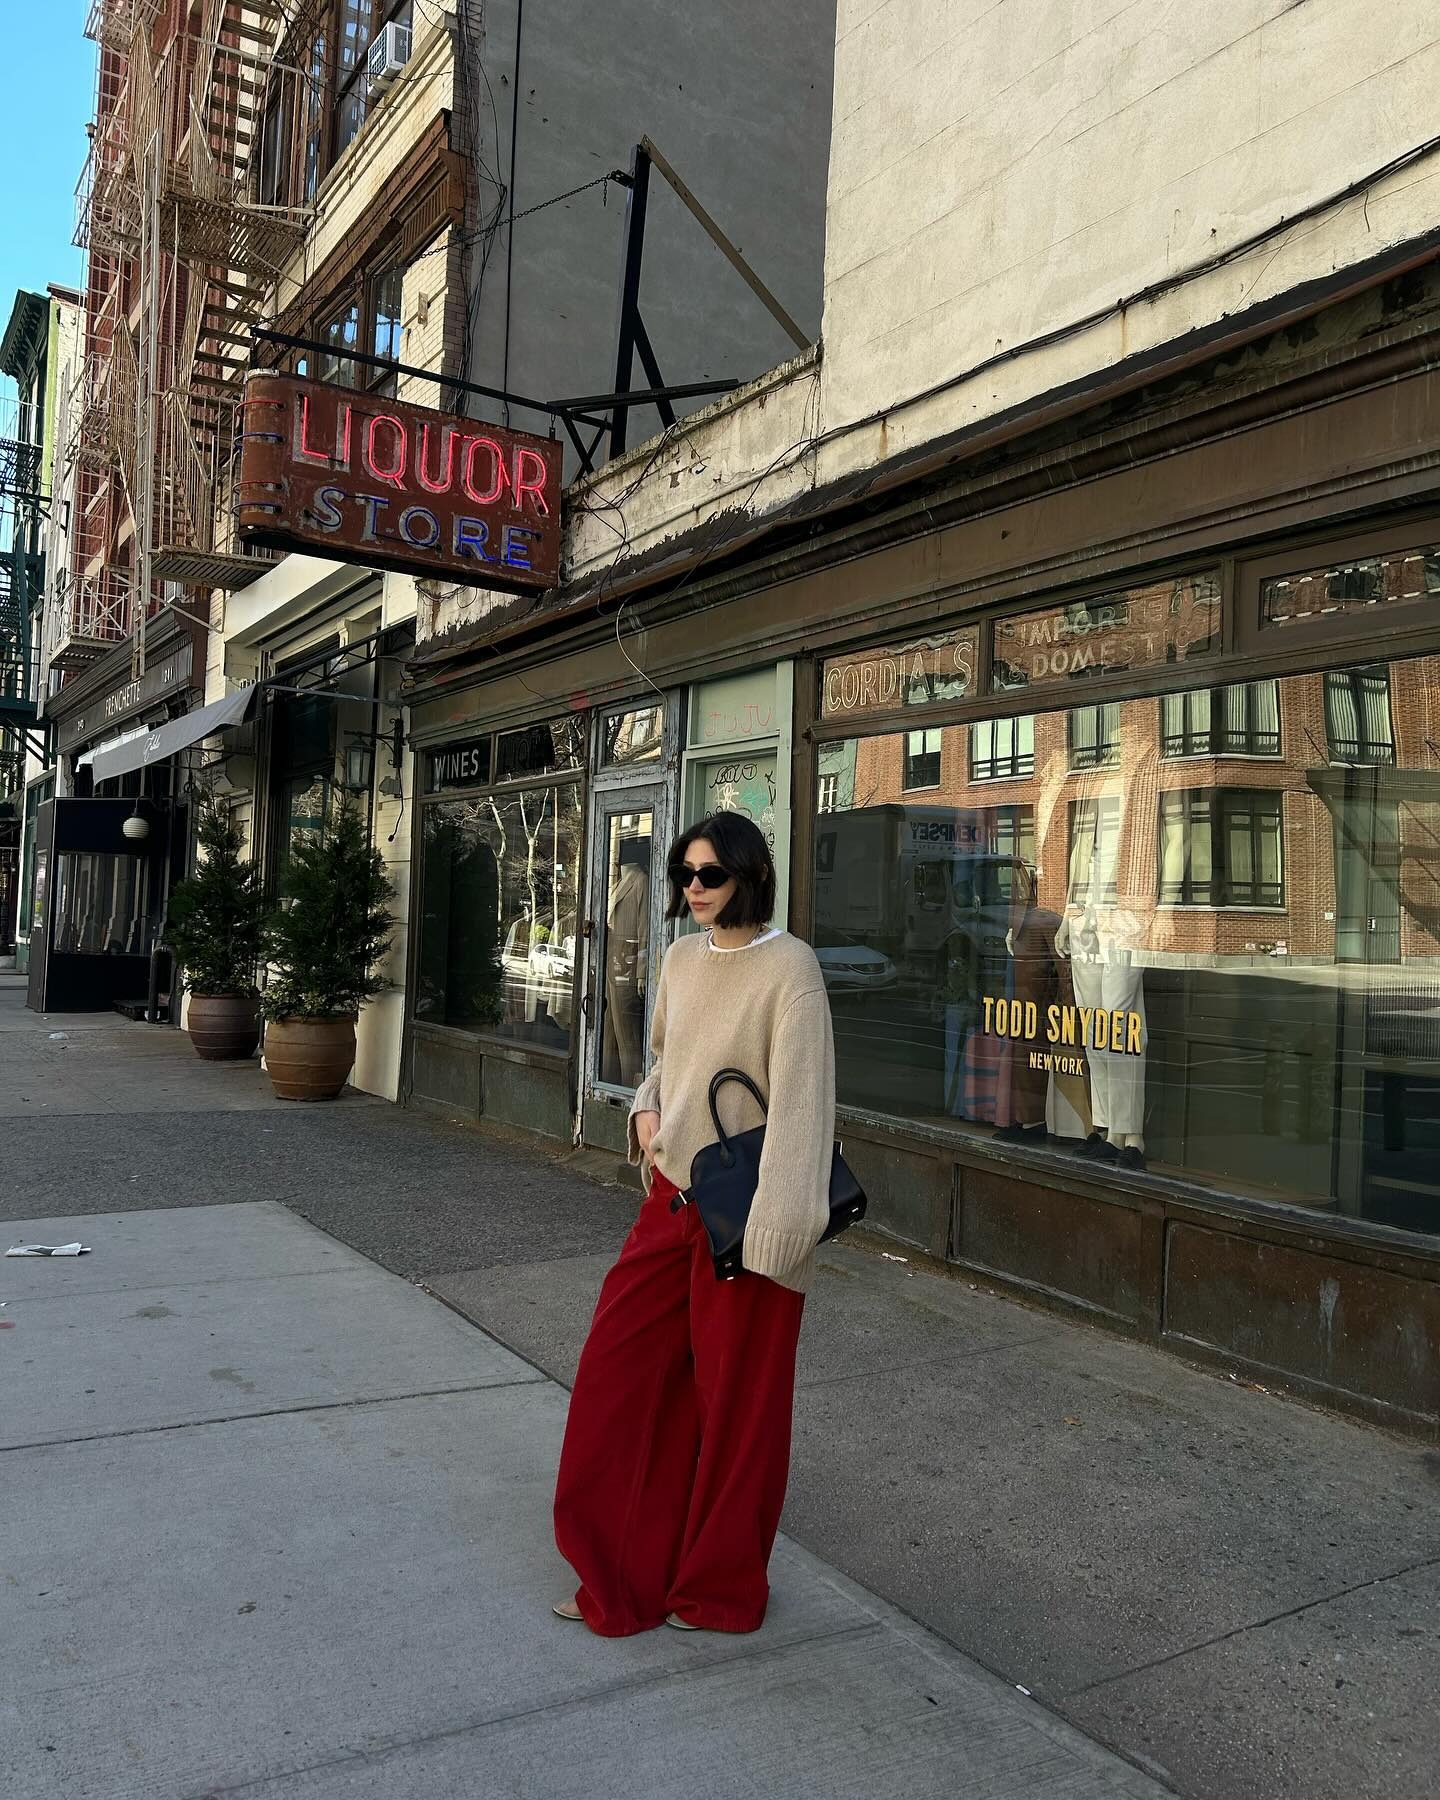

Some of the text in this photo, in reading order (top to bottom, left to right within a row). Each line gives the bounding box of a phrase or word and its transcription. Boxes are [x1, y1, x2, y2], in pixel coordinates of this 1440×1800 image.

[293, 394, 549, 517] LIQUOR
[308, 485, 534, 570] STORE
[1020, 589, 1185, 648] IMPORTED
[825, 641, 973, 713] CORDIALS
[1032, 624, 1192, 679] DOMESTIC
[104, 681, 141, 719] FRENCHETTE
[434, 748, 480, 780] WINES
[983, 997, 1141, 1056] TODD SNYDER
[1029, 1052, 1084, 1077] NEW YORK
